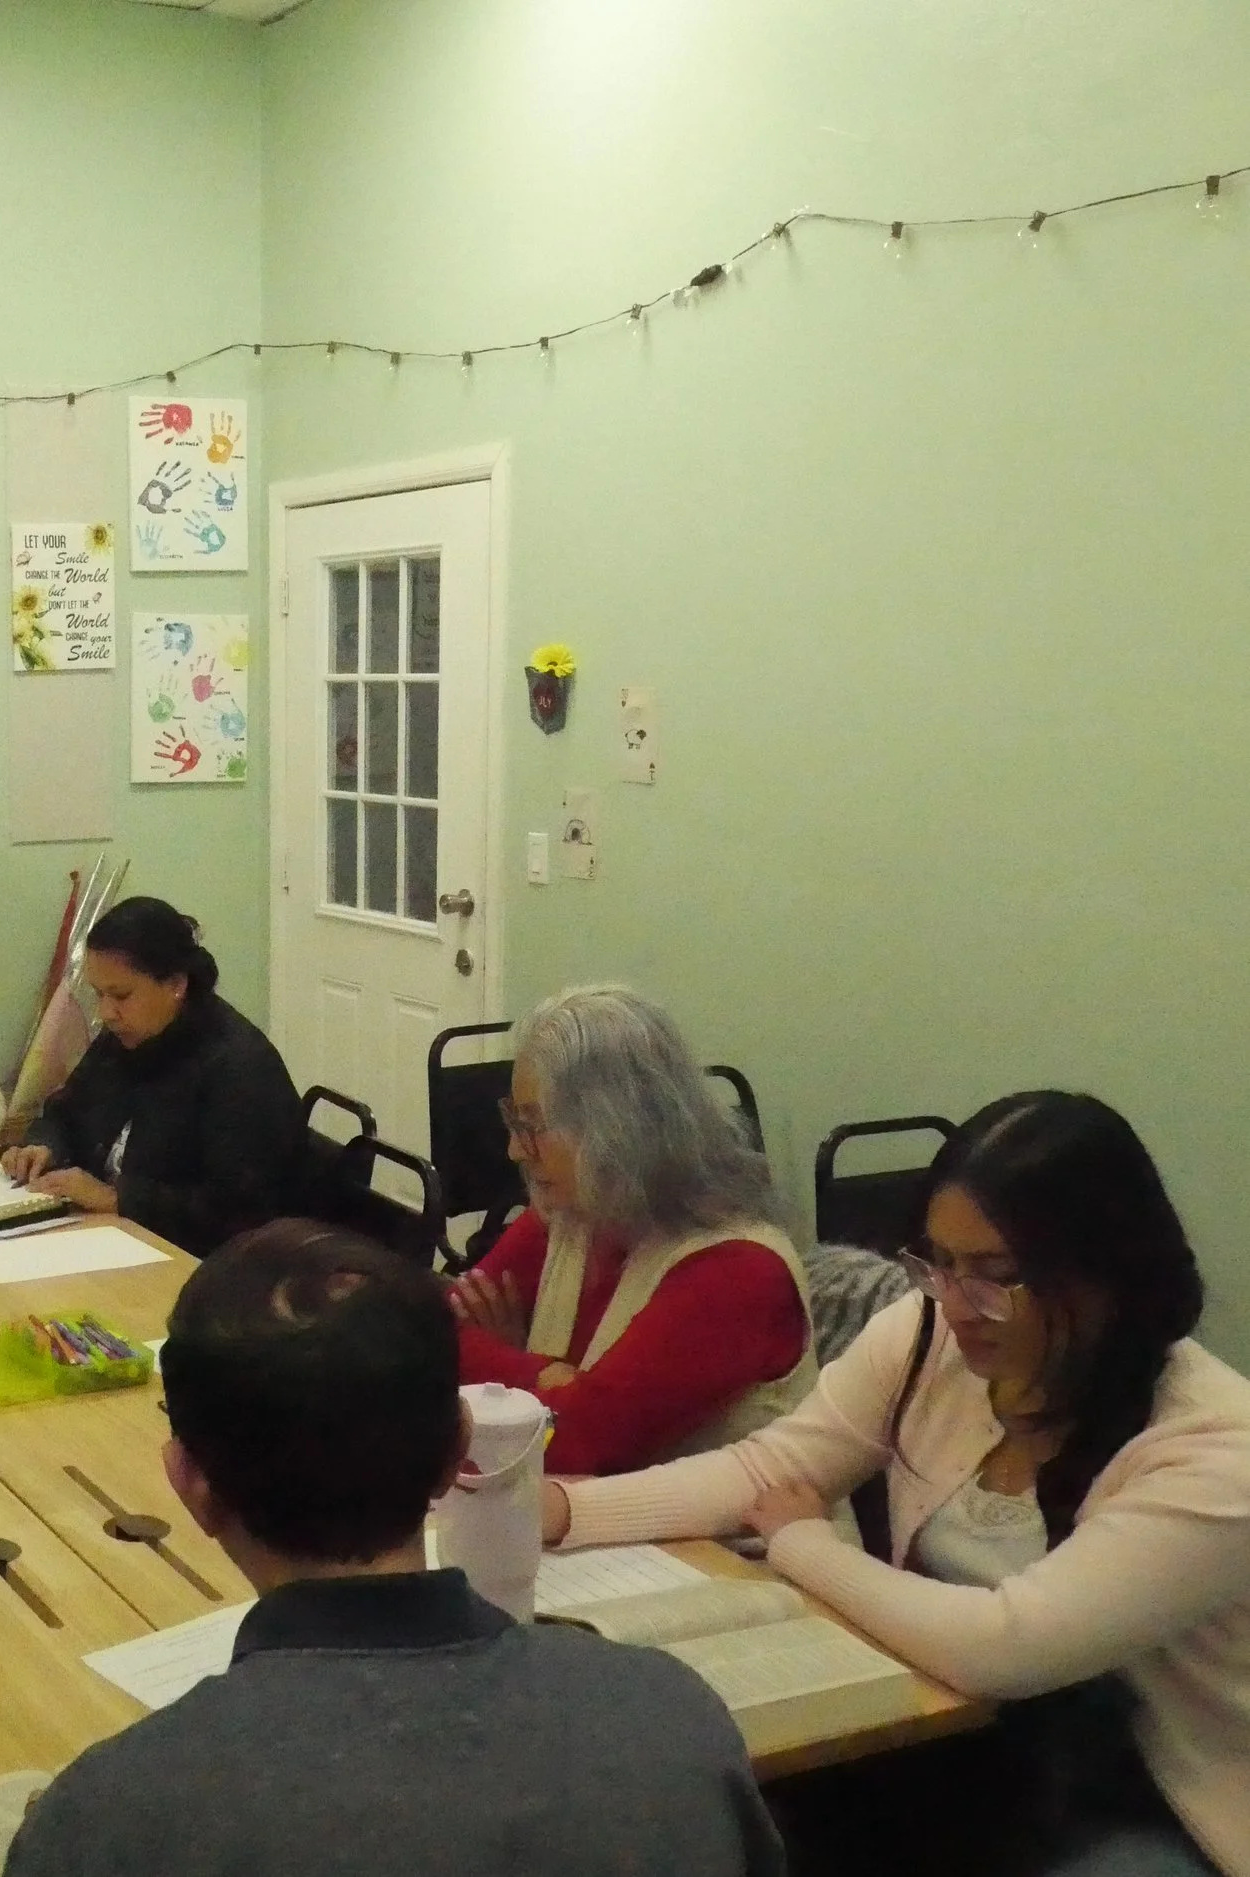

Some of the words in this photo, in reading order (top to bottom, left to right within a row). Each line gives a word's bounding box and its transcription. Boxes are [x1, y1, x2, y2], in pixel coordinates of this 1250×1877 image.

[24, 534, 39, 549] LET
[42, 534, 67, 549] YOUR
[55, 551, 90, 565] Smile
[25, 570, 49, 580] CHANGE
[51, 570, 61, 580] THE
[64, 567, 110, 584] World
[48, 584, 67, 597] but
[68, 600, 78, 610] LET
[80, 600, 90, 610] THE
[65, 613, 111, 629] World
[90, 634, 112, 647] your
[67, 645, 111, 662] Smile
